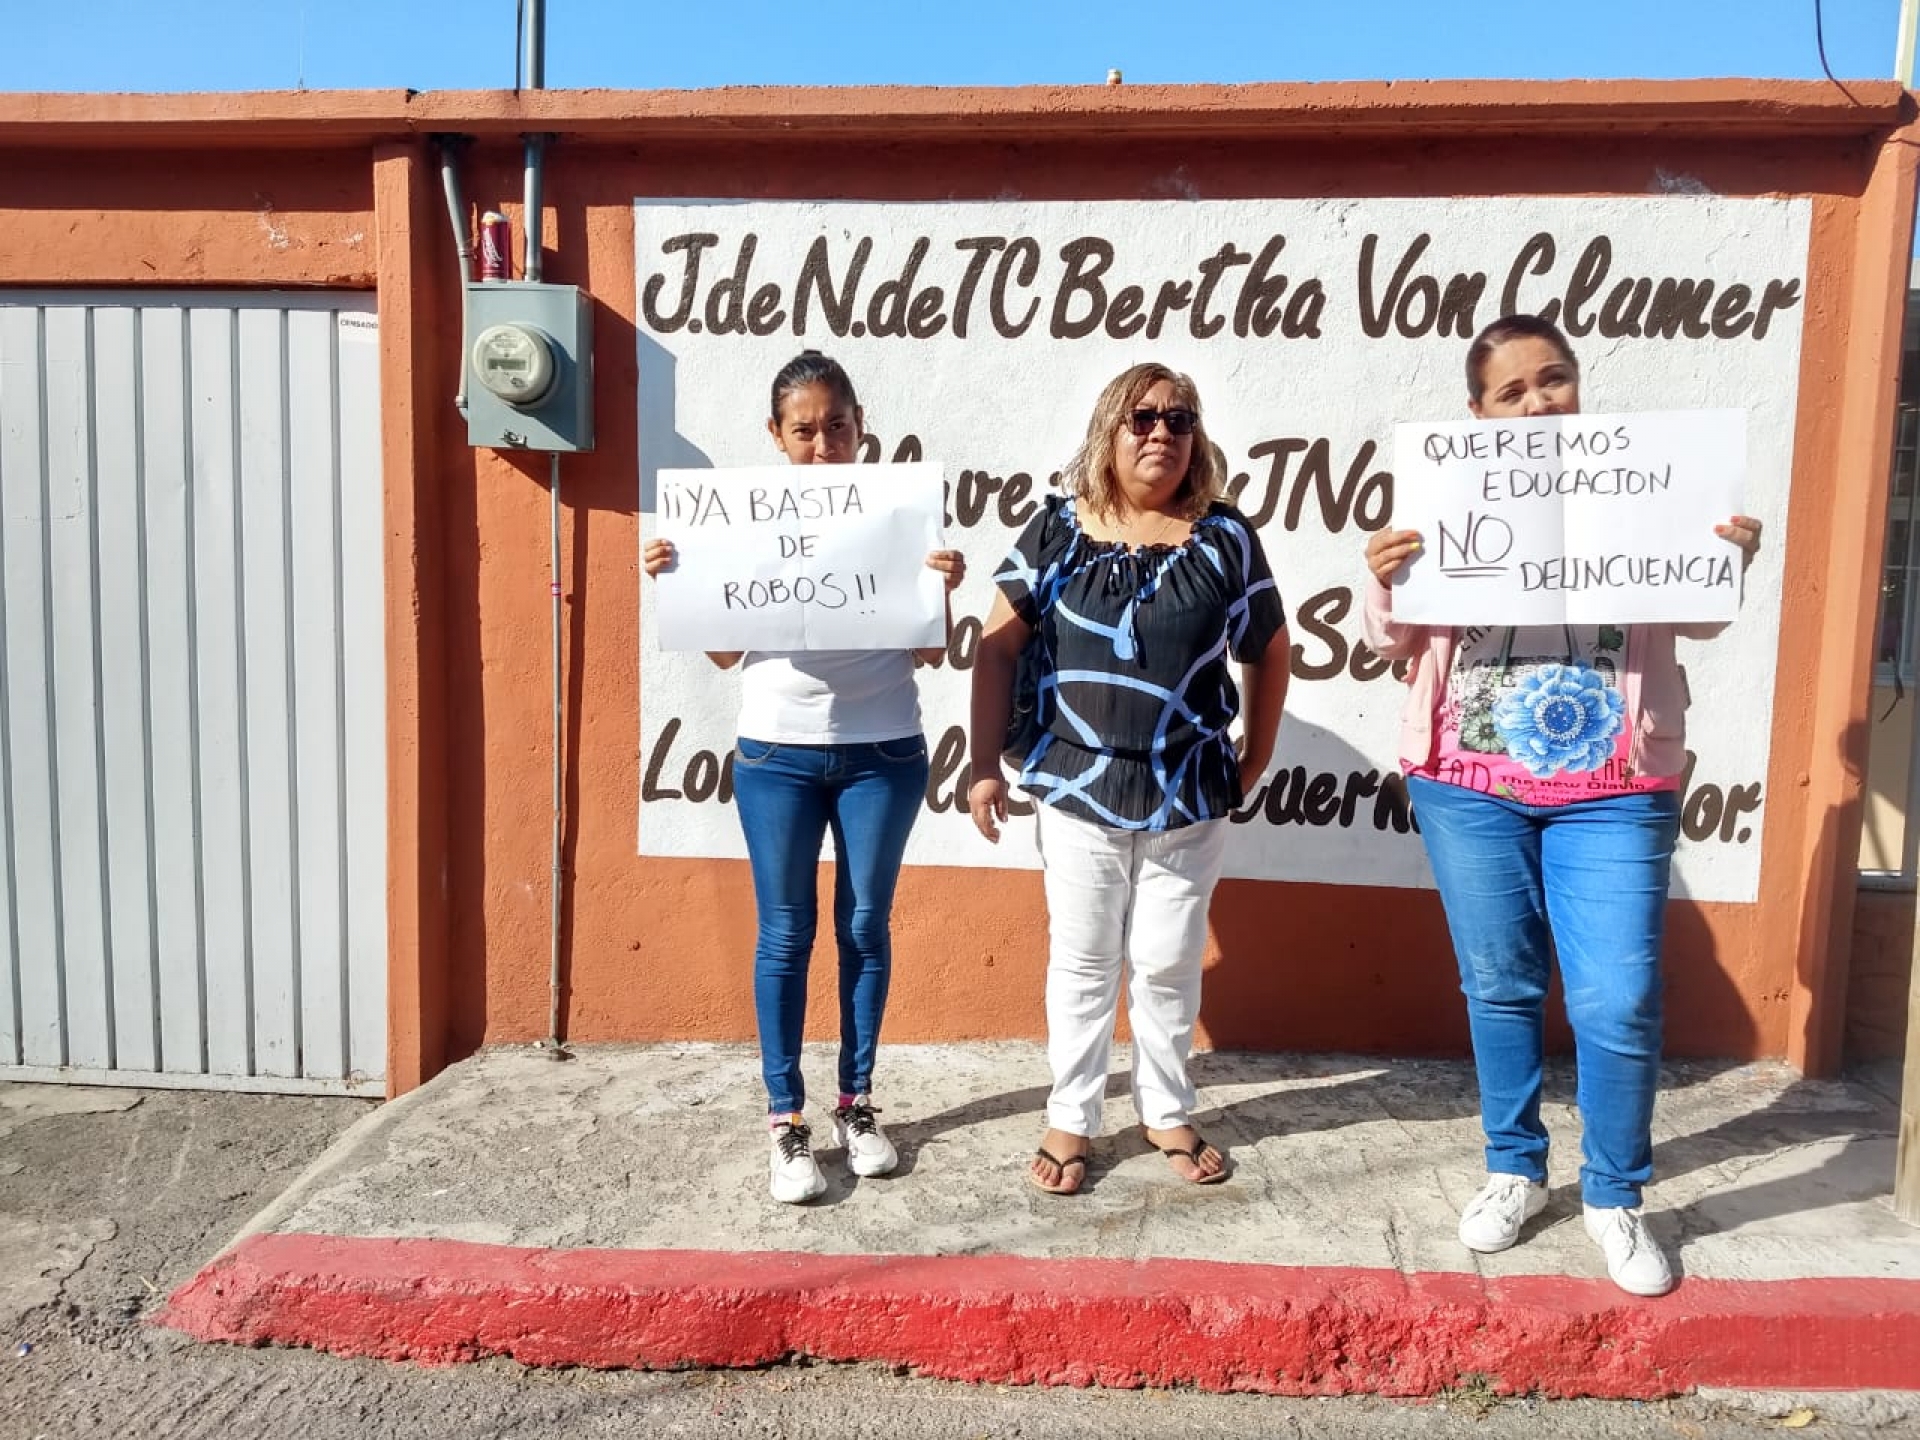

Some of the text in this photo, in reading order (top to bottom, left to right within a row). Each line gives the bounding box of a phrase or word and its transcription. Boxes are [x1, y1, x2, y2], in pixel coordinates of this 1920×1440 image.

[1050, 234, 1326, 339] Bertha
[1358, 233, 1487, 340] Von
[1424, 426, 1631, 466] QUEREMOS
[1483, 464, 1671, 501] EDUCACION
[749, 483, 863, 523] BASTA
[778, 535, 819, 558] DE
[1438, 510, 1735, 592] NO DELINCUENCIA
